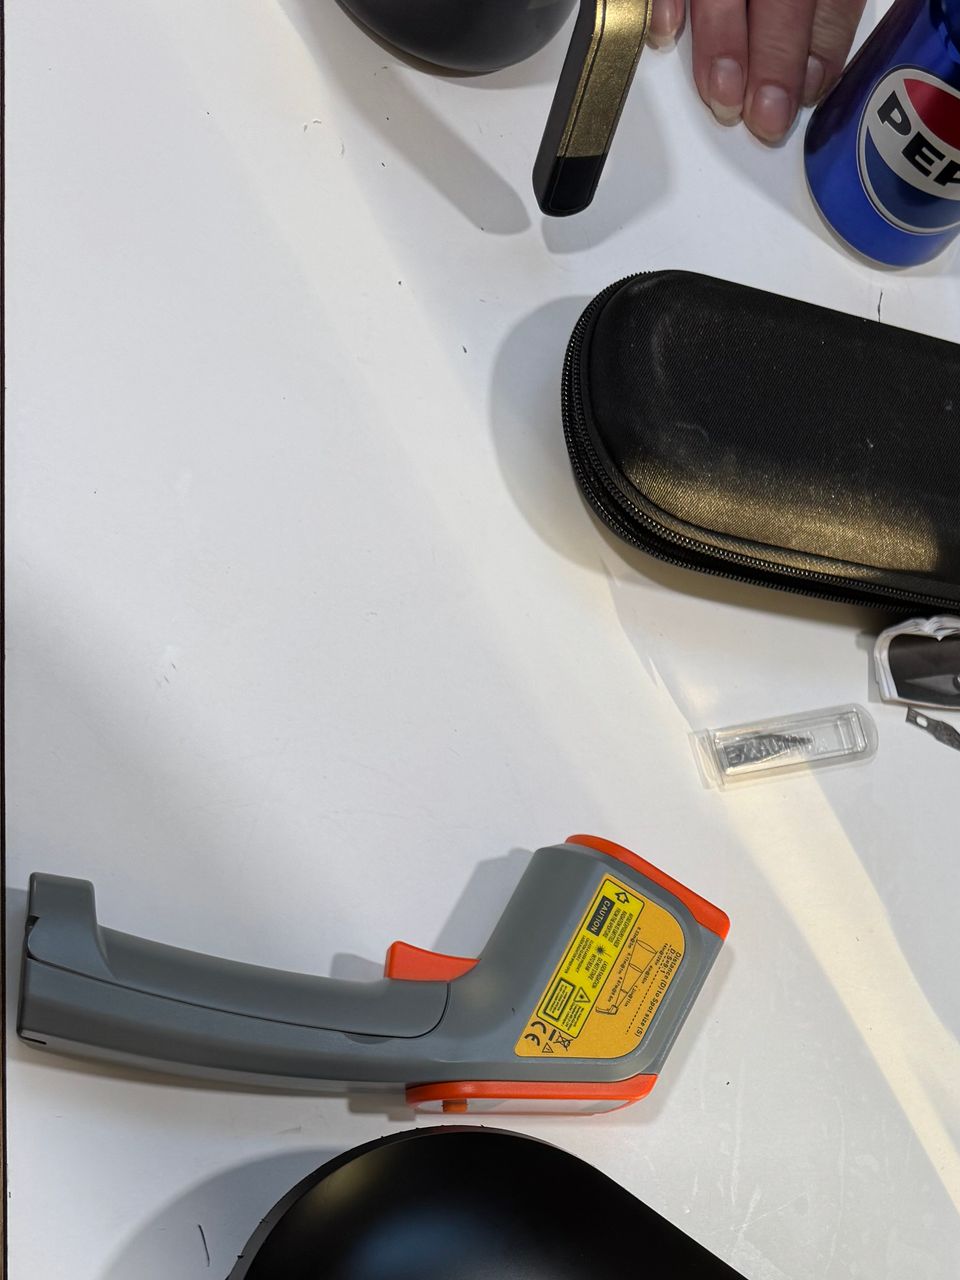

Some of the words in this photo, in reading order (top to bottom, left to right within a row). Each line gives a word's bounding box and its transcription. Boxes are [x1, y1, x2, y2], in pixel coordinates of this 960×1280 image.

[589, 899, 611, 933] CAUTION
[663, 950, 681, 980] Distance
[657, 978, 667, 990] (D)
[645, 996, 658, 1013] Spot
[639, 1012, 649, 1027] size
[633, 1025, 643, 1037] (S)
